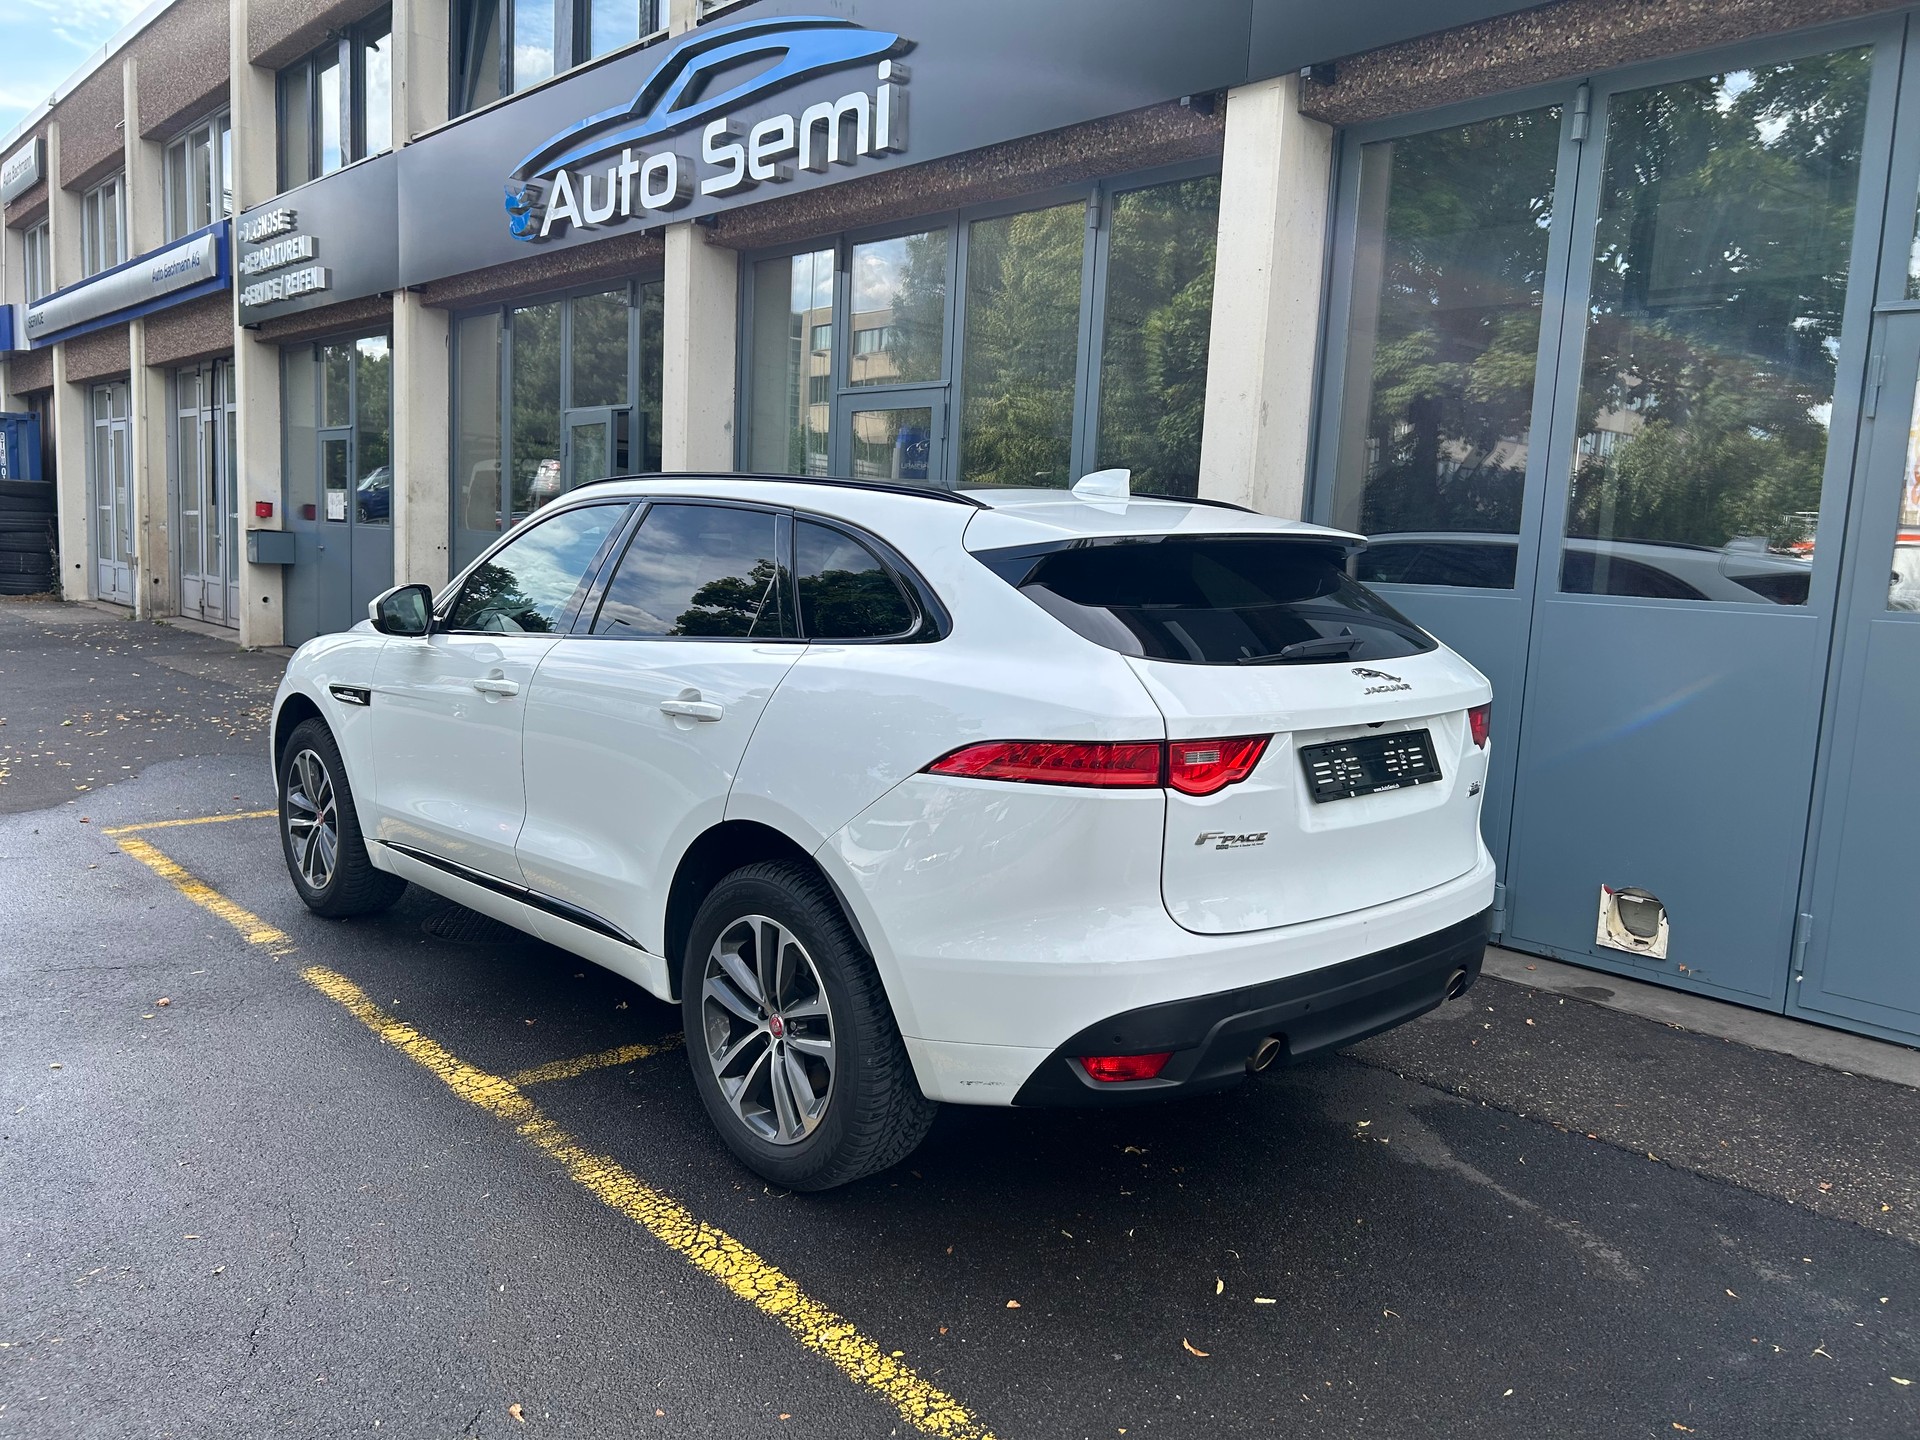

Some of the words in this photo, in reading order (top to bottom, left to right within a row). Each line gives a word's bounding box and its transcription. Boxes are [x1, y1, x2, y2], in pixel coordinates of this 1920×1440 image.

[540, 147, 679, 237] Auto
[701, 59, 893, 195] Semi
[152, 267, 163, 283] Auto
[164, 259, 190, 279] Bachmann
[192, 250, 200, 268] AG
[244, 234, 313, 274] REPARATUREN
[28, 311, 44, 329] SERVICE
[1363, 683, 1412, 695] JAGUAR
